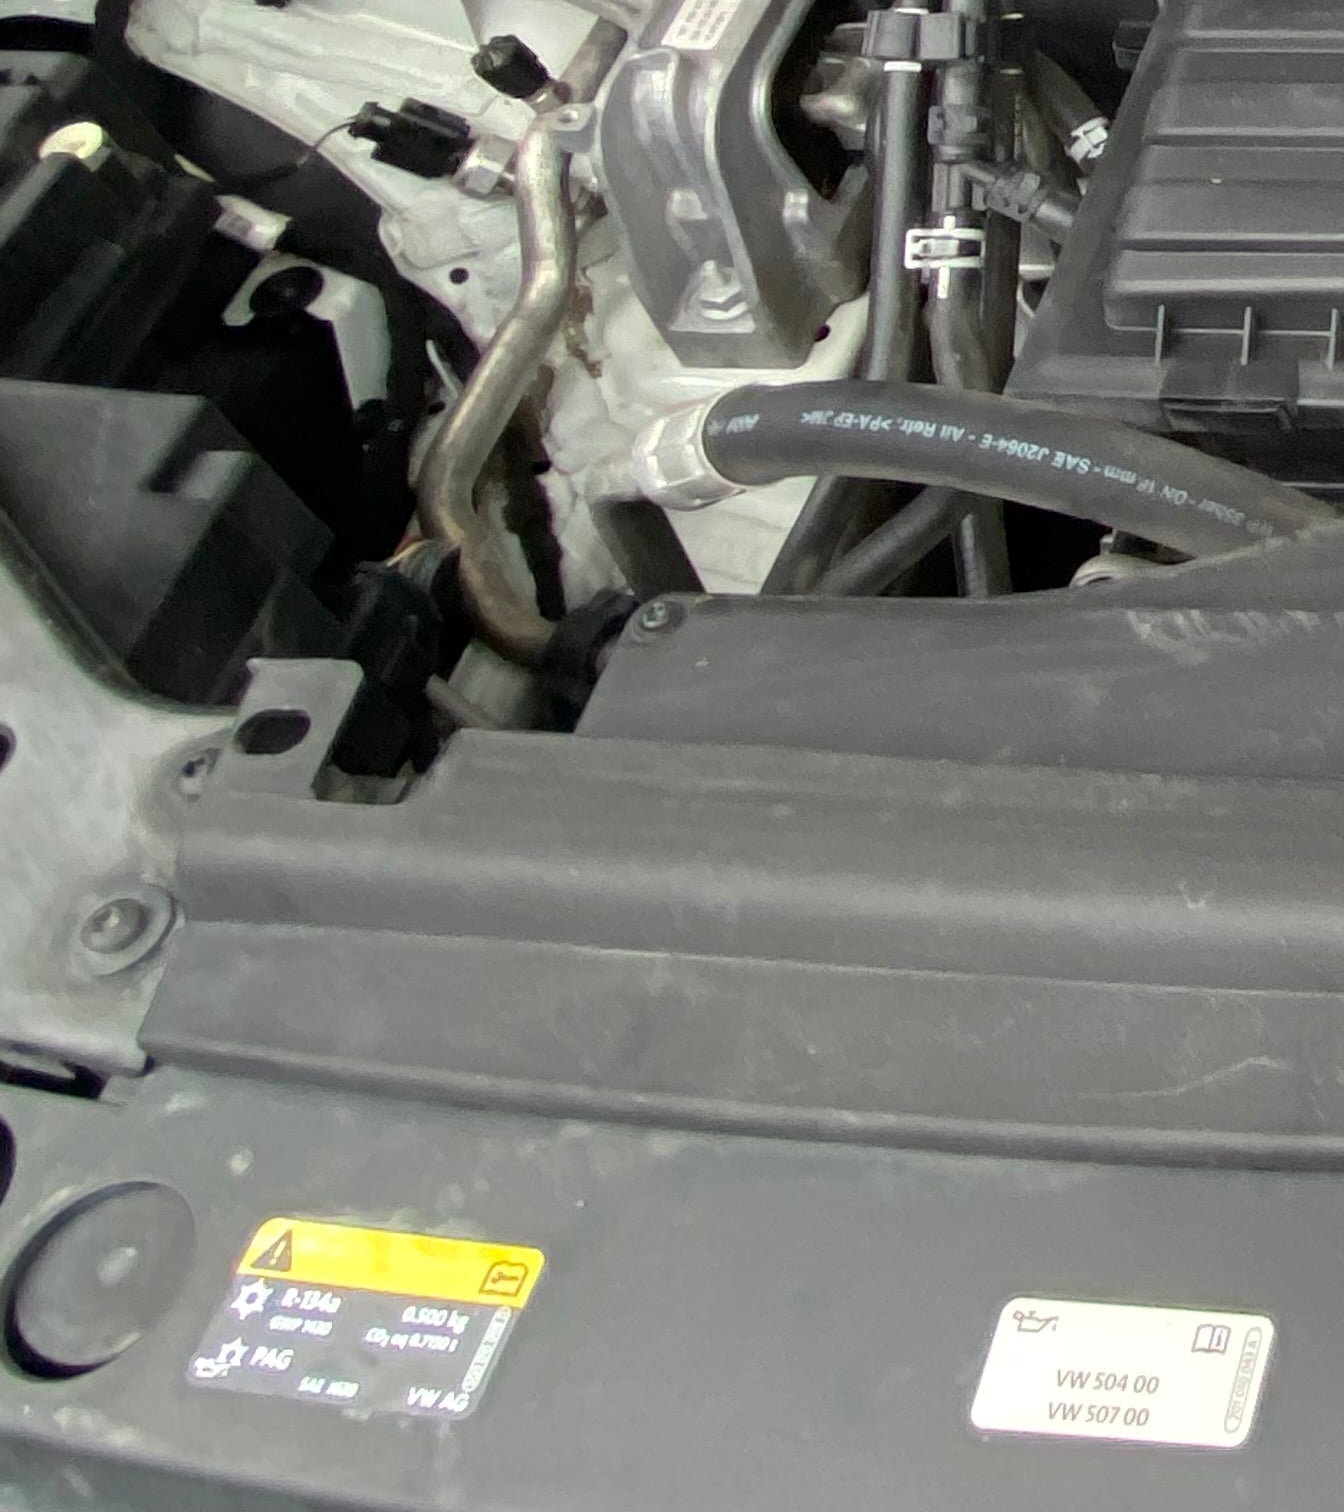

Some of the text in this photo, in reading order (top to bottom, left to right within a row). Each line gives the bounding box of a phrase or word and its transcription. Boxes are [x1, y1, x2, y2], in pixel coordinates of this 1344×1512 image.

[979, 433, 1050, 462] J2064-E
[1050, 451, 1091, 475] SAE
[280, 1287, 342, 1313] R-134a
[249, 1345, 295, 1371] PAG
[1056, 1368, 1160, 1394] VW 504 00
[407, 1387, 441, 1408] VW
[438, 1391, 470, 1412] AG
[1048, 1401, 1150, 1427] VW 507 00
